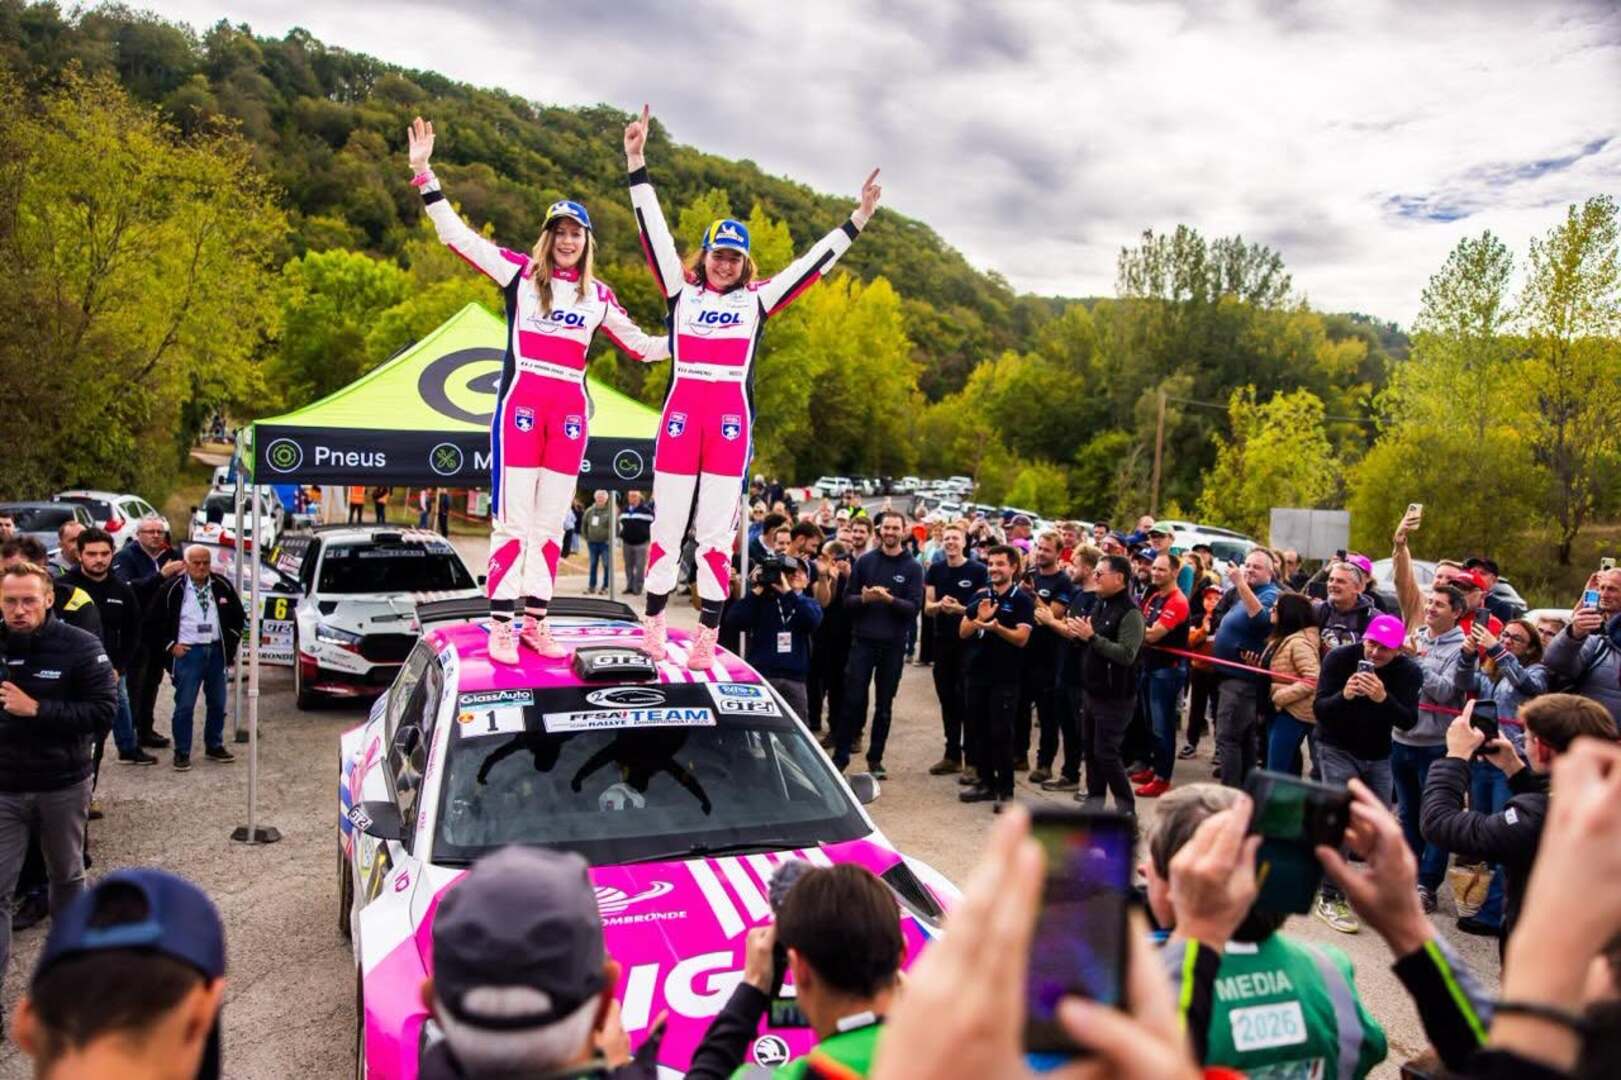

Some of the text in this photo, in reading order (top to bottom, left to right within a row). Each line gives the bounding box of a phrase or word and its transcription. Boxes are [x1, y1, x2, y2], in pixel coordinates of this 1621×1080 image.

[698, 310, 740, 324] IGOL
[315, 447, 386, 467] Pneus
[274, 598, 288, 620] 6
[486, 710, 499, 731] 1
[631, 709, 709, 721] TEAM
[1213, 970, 1292, 1001] MEDIA
